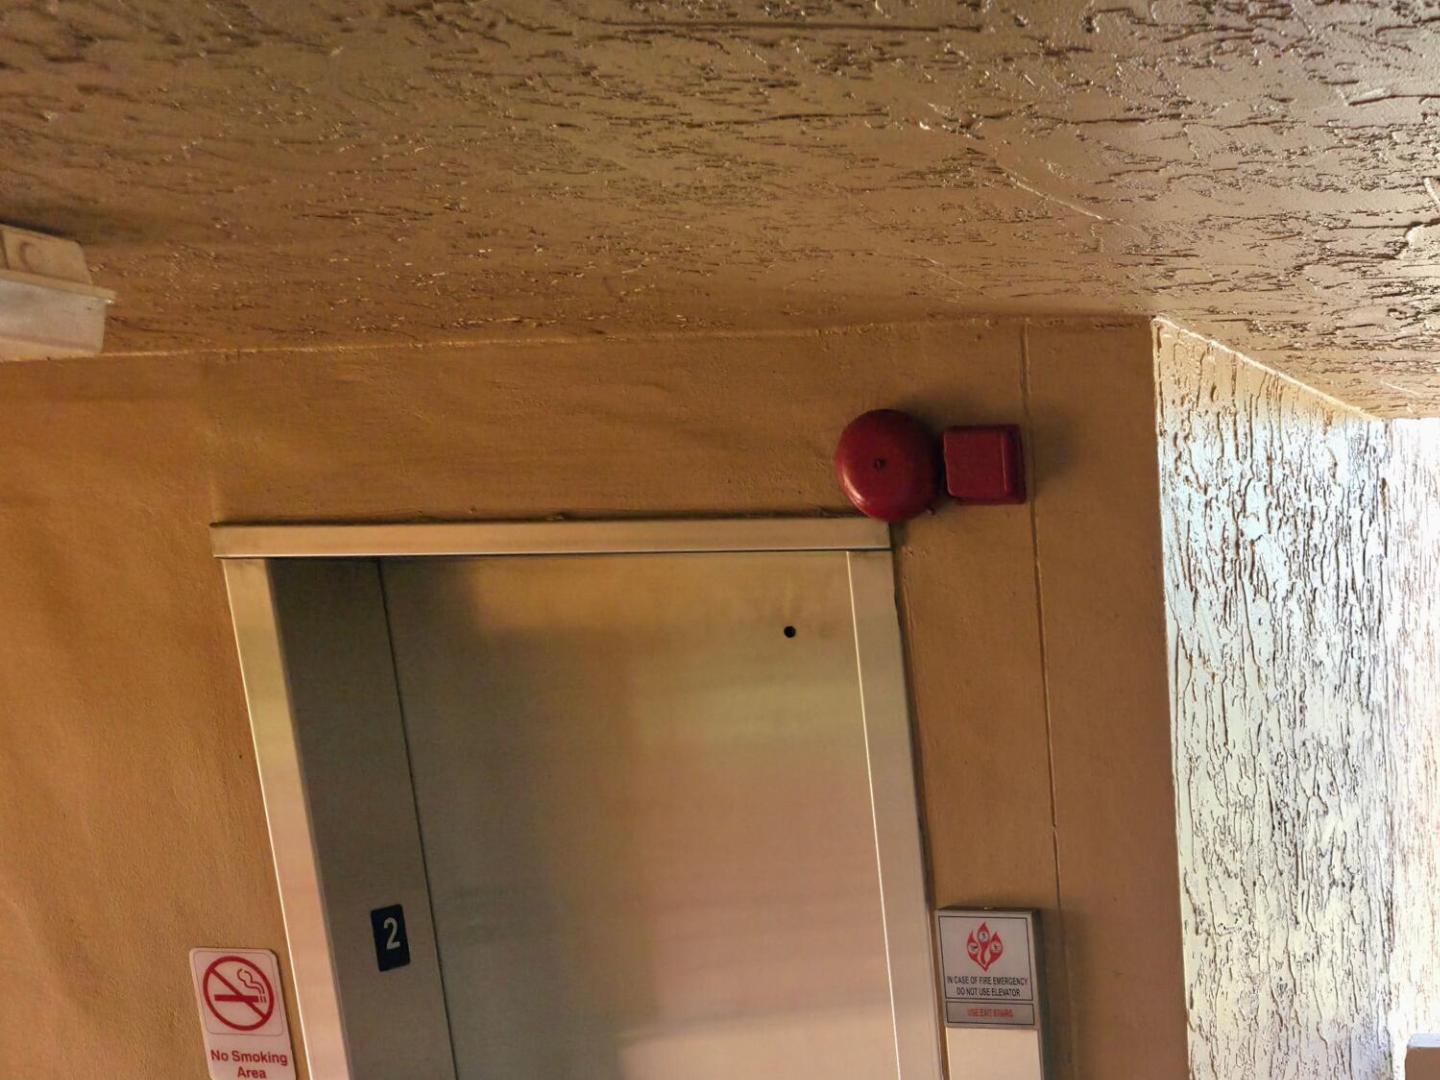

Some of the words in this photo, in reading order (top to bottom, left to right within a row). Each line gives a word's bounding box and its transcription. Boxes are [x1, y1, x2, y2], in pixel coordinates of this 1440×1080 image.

[383, 917, 400, 951] 2
[946, 976, 953, 984] IN
[954, 976, 969, 985] CASE
[970, 976, 978, 985] OF
[979, 976, 992, 985] FIRE
[992, 977, 1028, 987] EMERGENCY
[956, 987, 965, 996] DO
[966, 987, 978, 996] NOT
[979, 987, 991, 996] USE
[991, 988, 1021, 997] ELEVATOR
[210, 1049, 229, 1063] No
[231, 1050, 288, 1066] Smoking
[237, 1066, 267, 1080] Area
